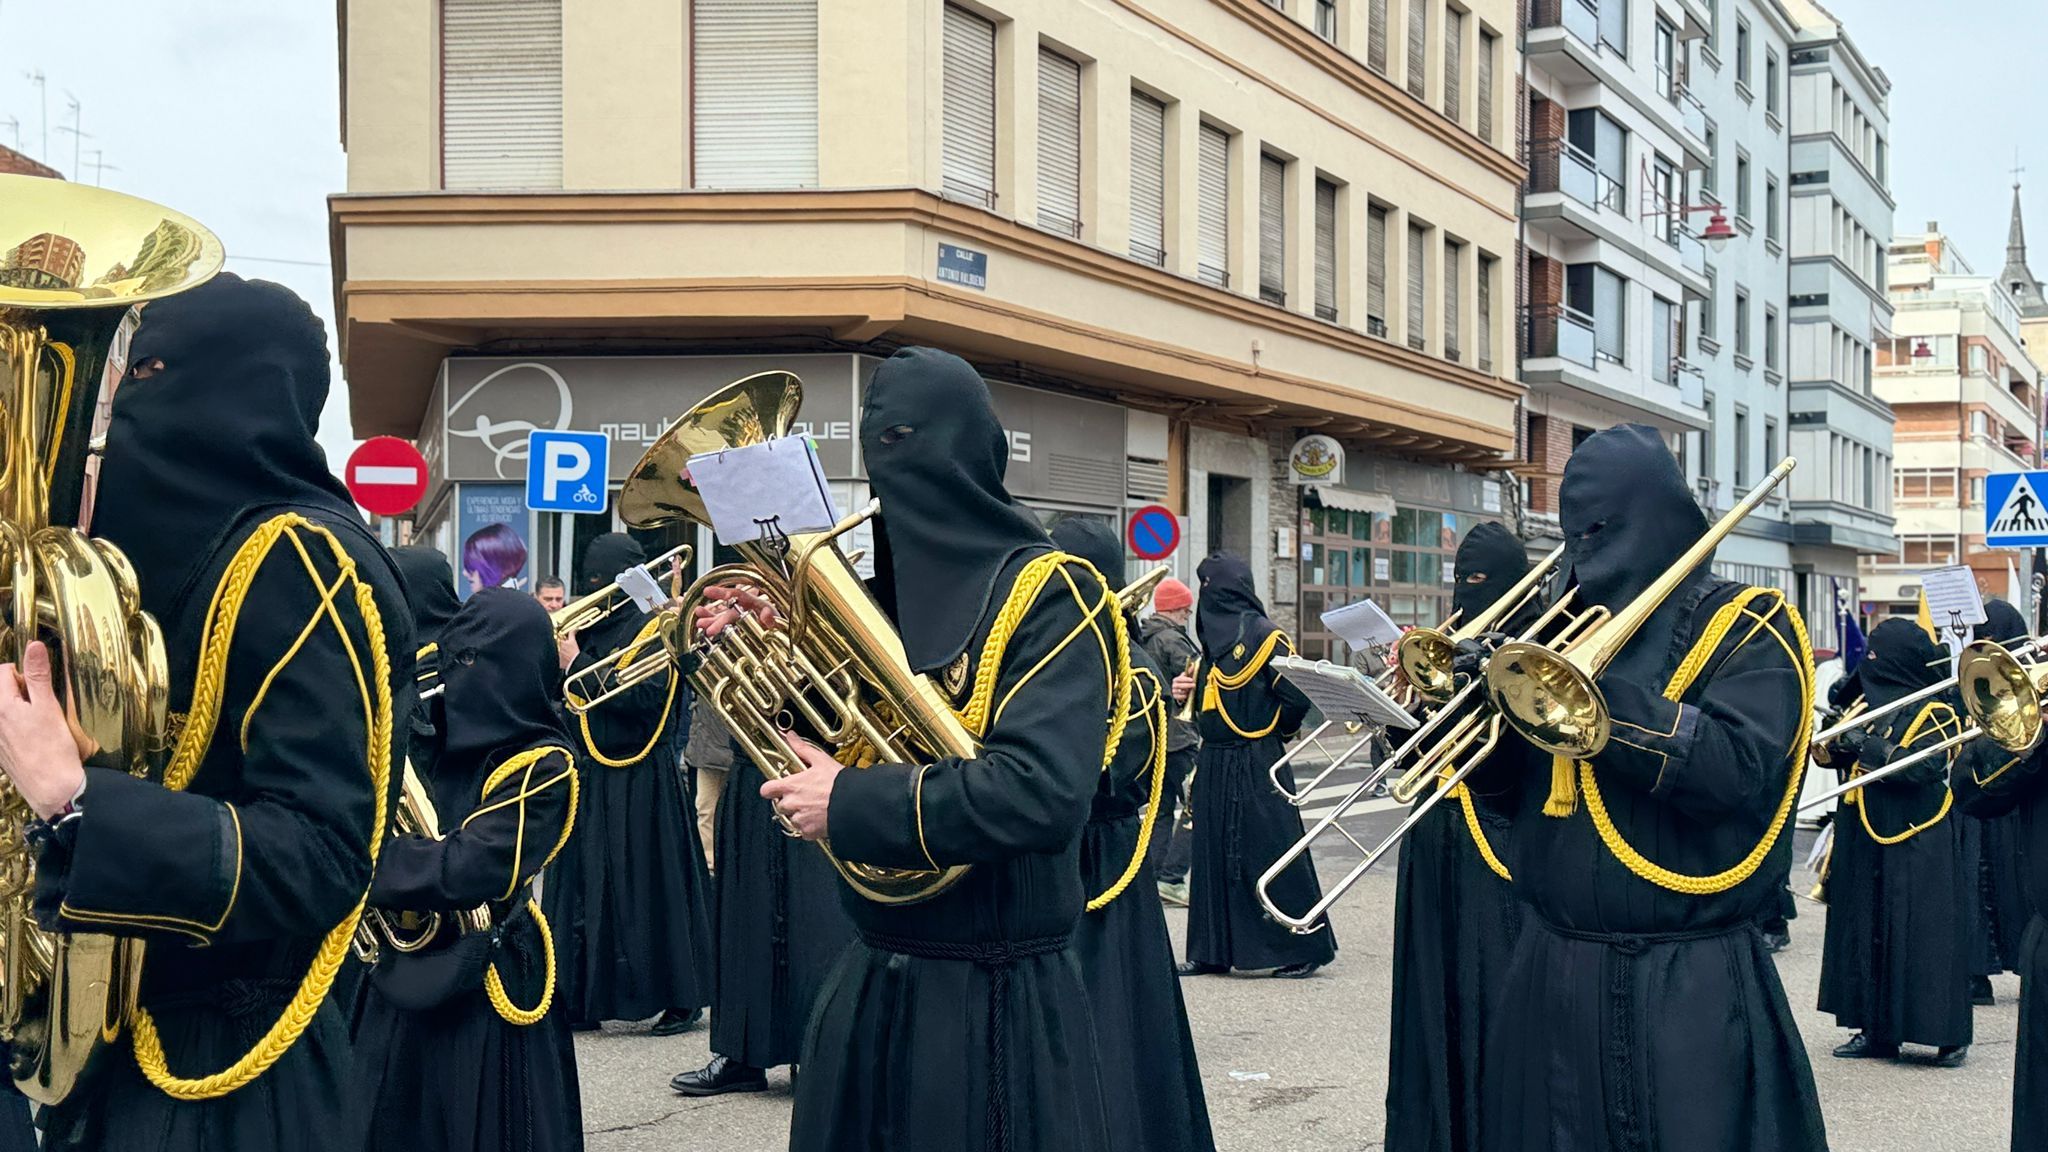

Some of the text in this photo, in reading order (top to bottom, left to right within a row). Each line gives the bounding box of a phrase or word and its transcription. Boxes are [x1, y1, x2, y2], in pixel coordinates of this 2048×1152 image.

[956, 249, 973, 261] CALLE
[938, 267, 960, 281] ANTONIO
[543, 440, 591, 502] P
